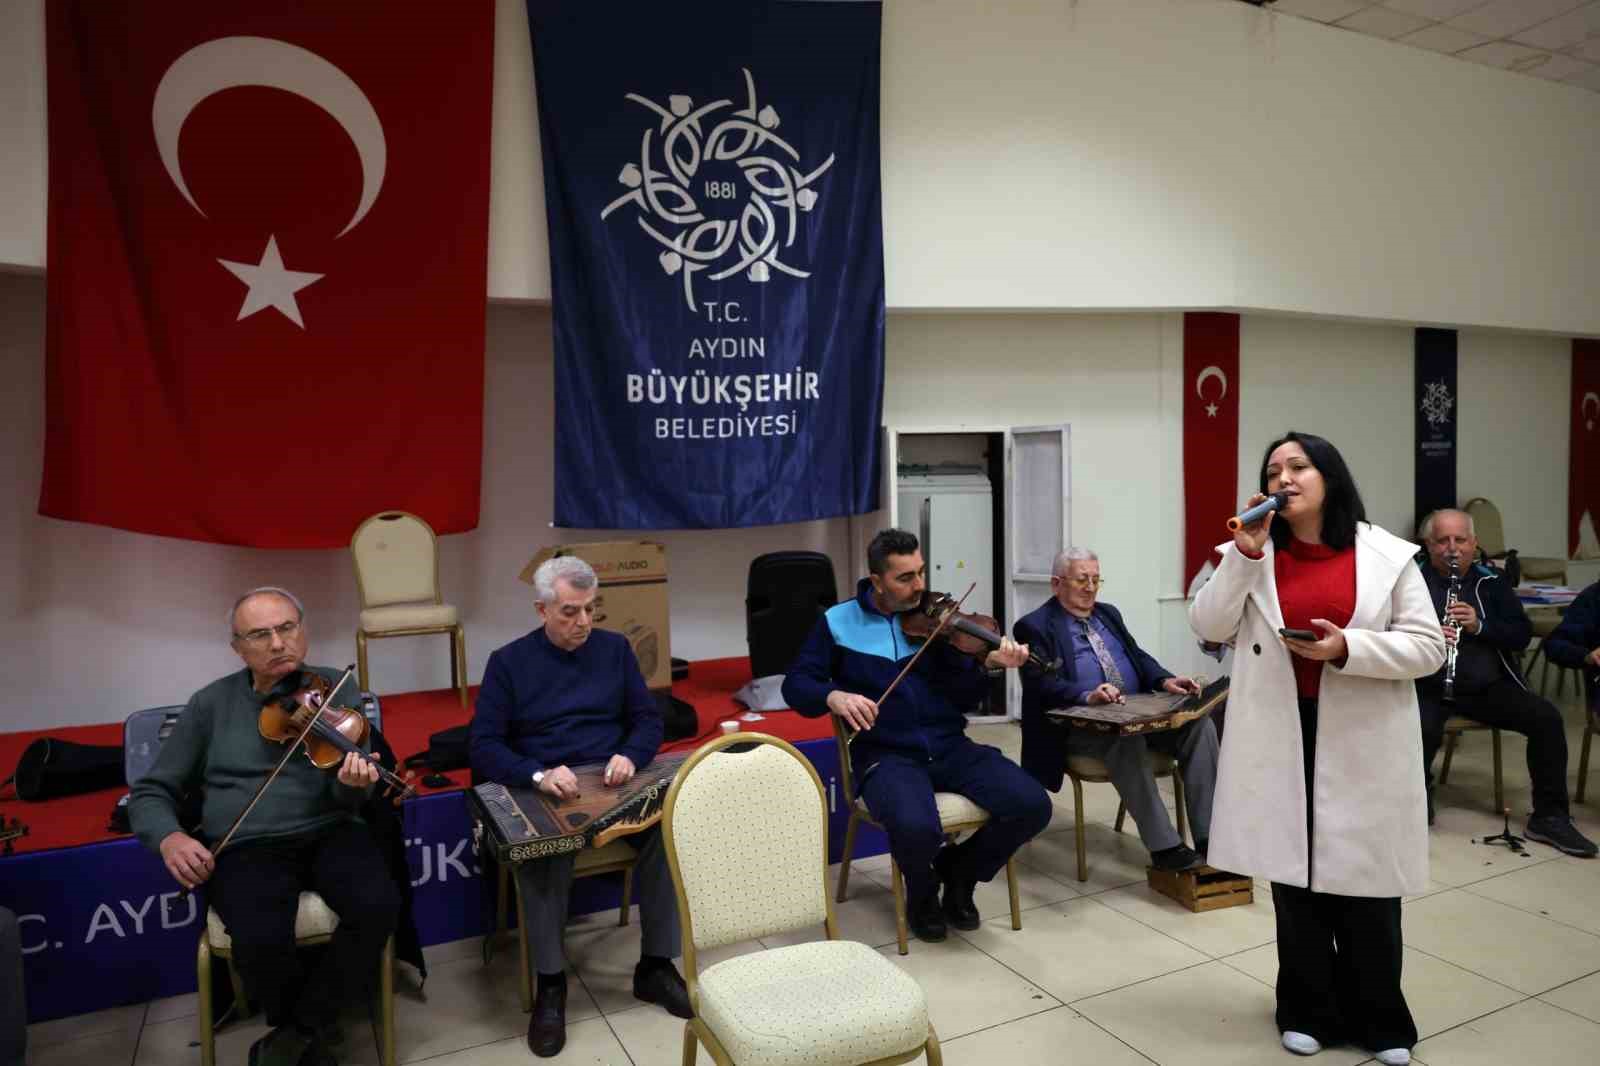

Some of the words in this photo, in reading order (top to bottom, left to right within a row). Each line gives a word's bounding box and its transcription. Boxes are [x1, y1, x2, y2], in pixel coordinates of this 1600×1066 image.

[704, 181, 736, 199] 1881
[703, 302, 748, 322] T.C.
[688, 337, 765, 359] AYDIN
[626, 367, 820, 411] BÜYÜKŞEHİR
[655, 411, 797, 439] BELEDİYESİ
[85, 891, 197, 943] AYD
